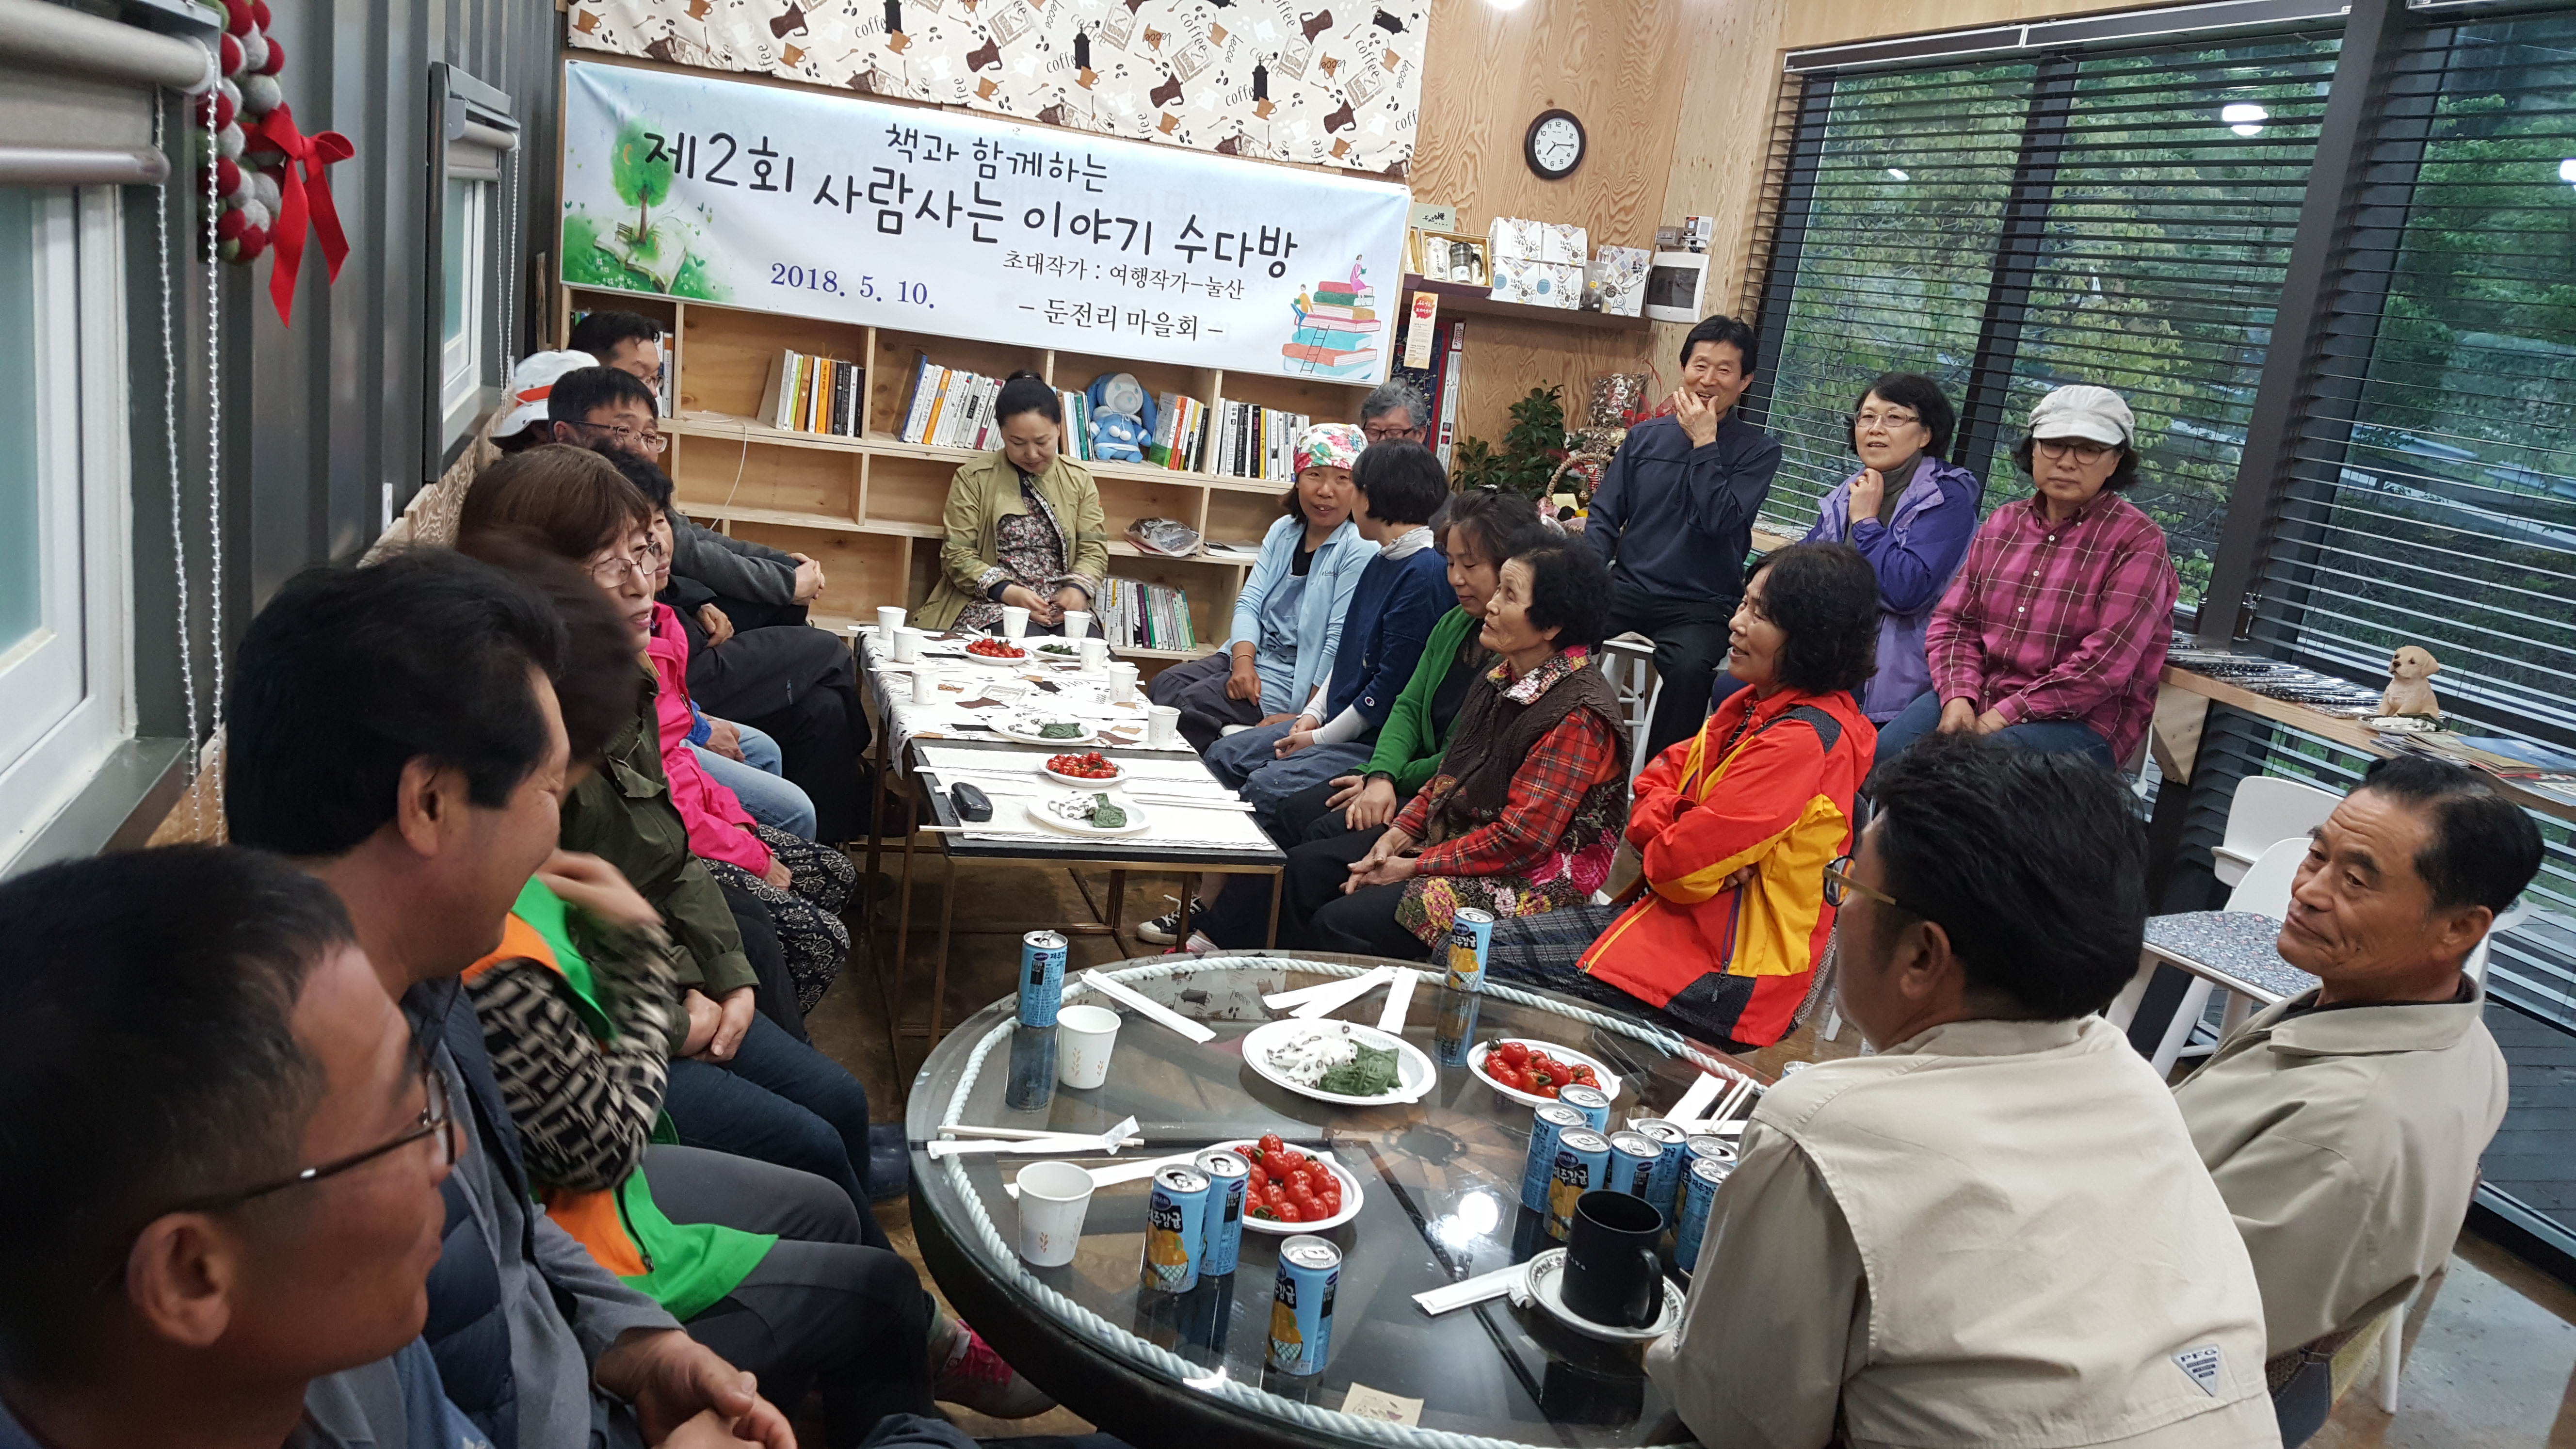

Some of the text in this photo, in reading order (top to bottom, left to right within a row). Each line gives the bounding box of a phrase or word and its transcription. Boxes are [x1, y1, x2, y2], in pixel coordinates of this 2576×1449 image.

[855, 15, 886, 38] coffe
[1180, 13, 1208, 52] coffee
[1046, 51, 1076, 73] coffe
[1225, 34, 1243, 64] lecce
[1355, 40, 1380, 77] coffee
[1396, 60, 1415, 89] lecce
[1225, 84, 1255, 106] coffe
[1395, 109, 1417, 131] coff
[885, 123, 1108, 193] 책과 함께하는
[644, 131, 1299, 279] 제2회 사람사는 이야기 수다방
[1002, 250, 1088, 281] 초대작가
[770, 262, 935, 309] 2018. 5. 10.
[1043, 299, 1117, 333] 둔전리
[1126, 308, 1198, 342] 마을회
[1150, 1211, 1182, 1230] 주감귤
